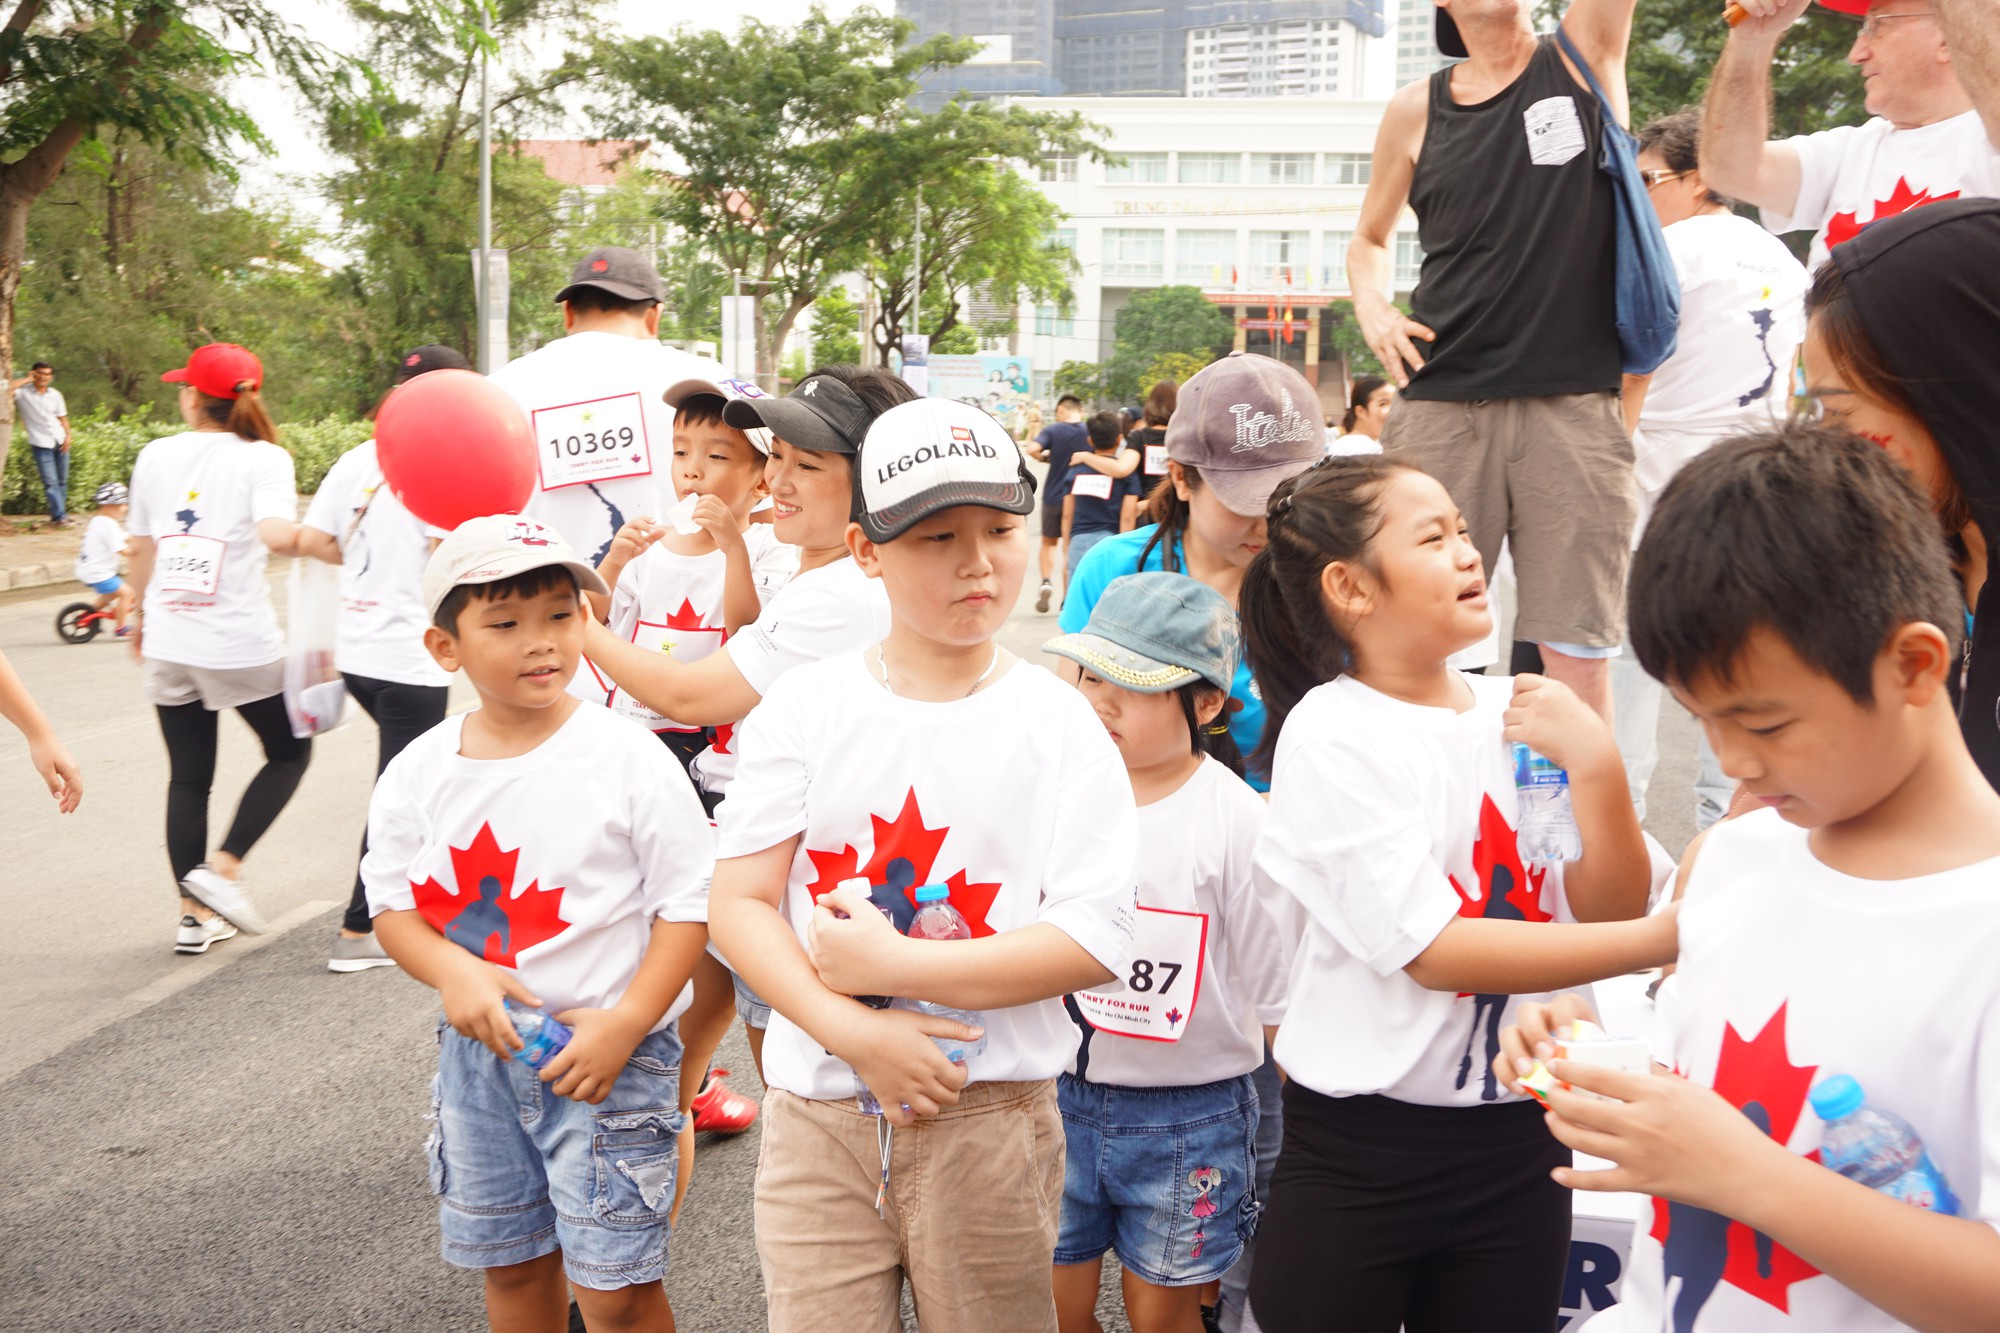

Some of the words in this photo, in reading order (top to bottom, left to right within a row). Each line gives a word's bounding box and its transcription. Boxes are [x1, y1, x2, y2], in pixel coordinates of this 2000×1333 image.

[549, 426, 634, 459] 10369
[878, 428, 997, 484] LEGOLAND
[1128, 959, 1182, 995] 87
[1107, 999, 1126, 1009] FOX
[1129, 1004, 1150, 1013] RUN
